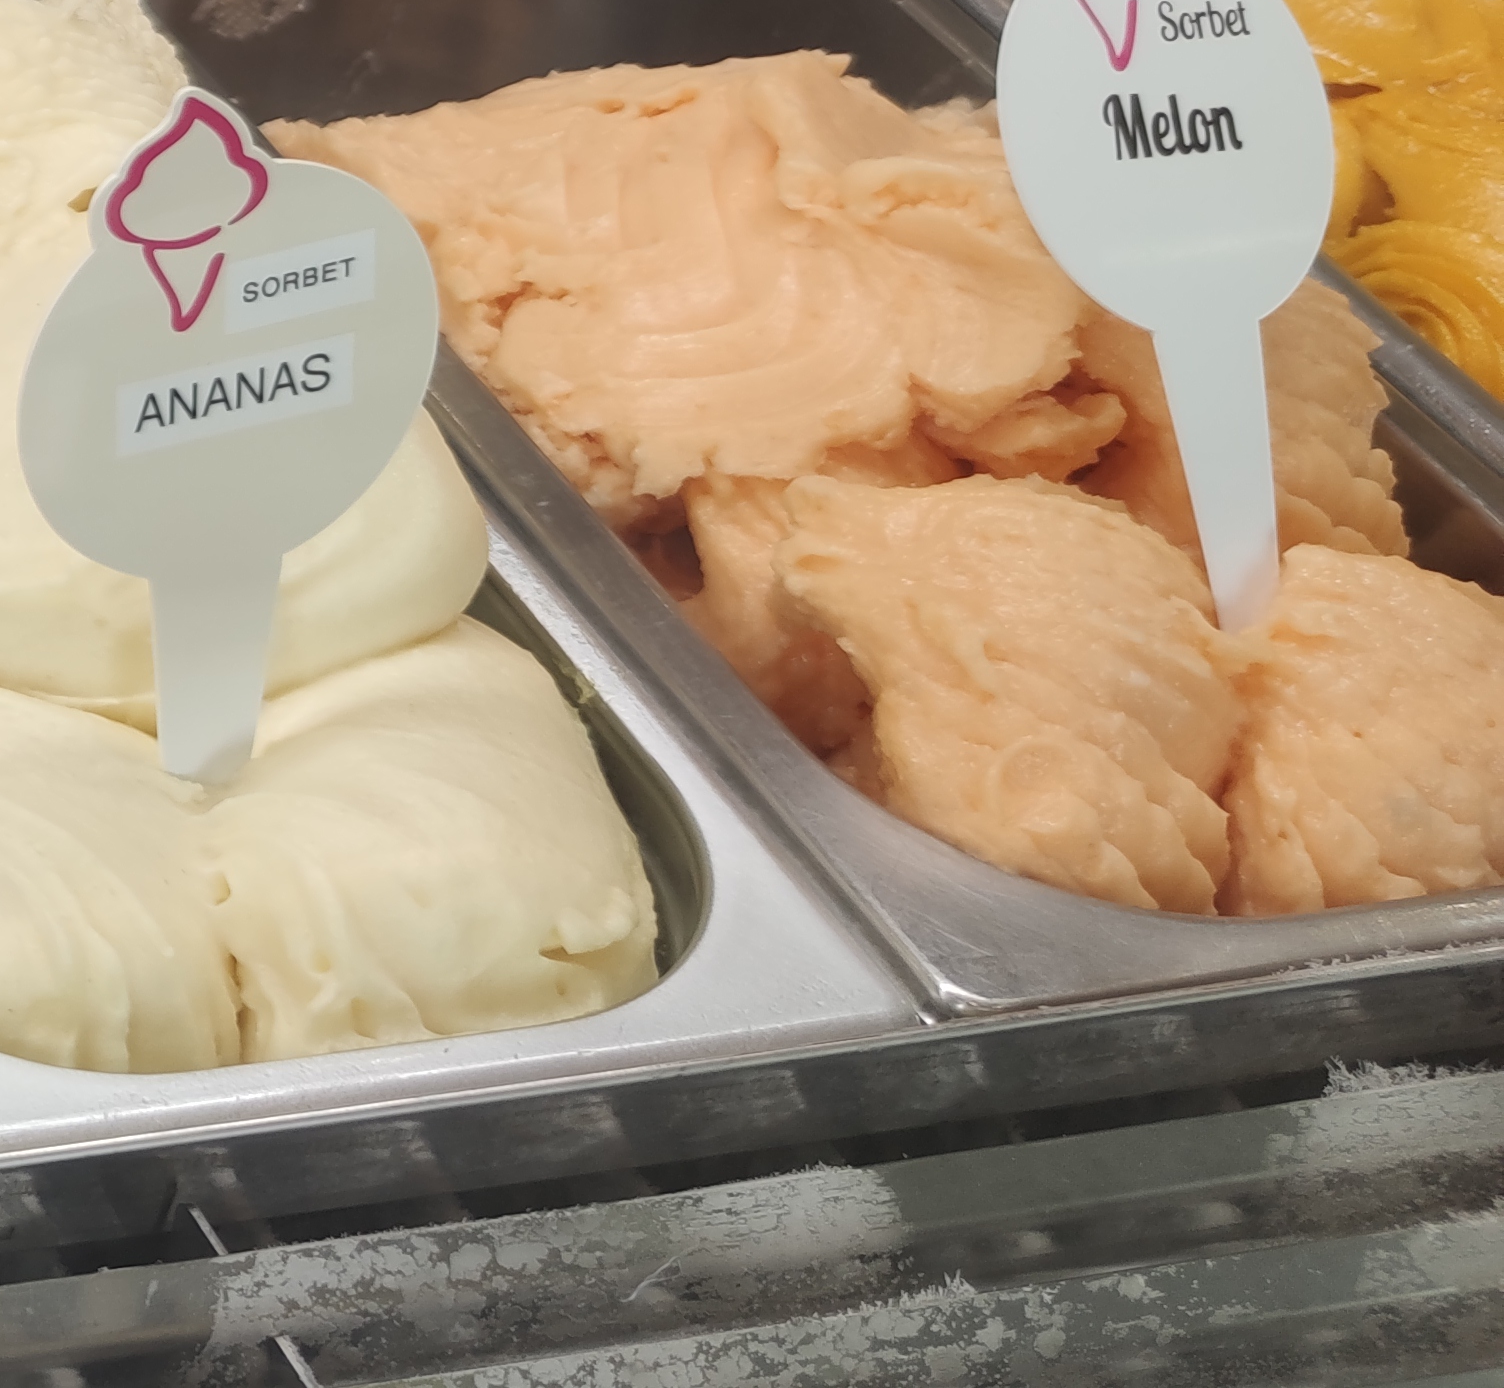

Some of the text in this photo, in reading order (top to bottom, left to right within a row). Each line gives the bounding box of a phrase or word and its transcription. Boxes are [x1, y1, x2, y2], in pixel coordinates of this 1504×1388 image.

[1157, 0, 1251, 42] Sorbet
[1102, 92, 1243, 160] Melon
[242, 256, 357, 303] SORBET
[134, 352, 331, 434] ANANAS
